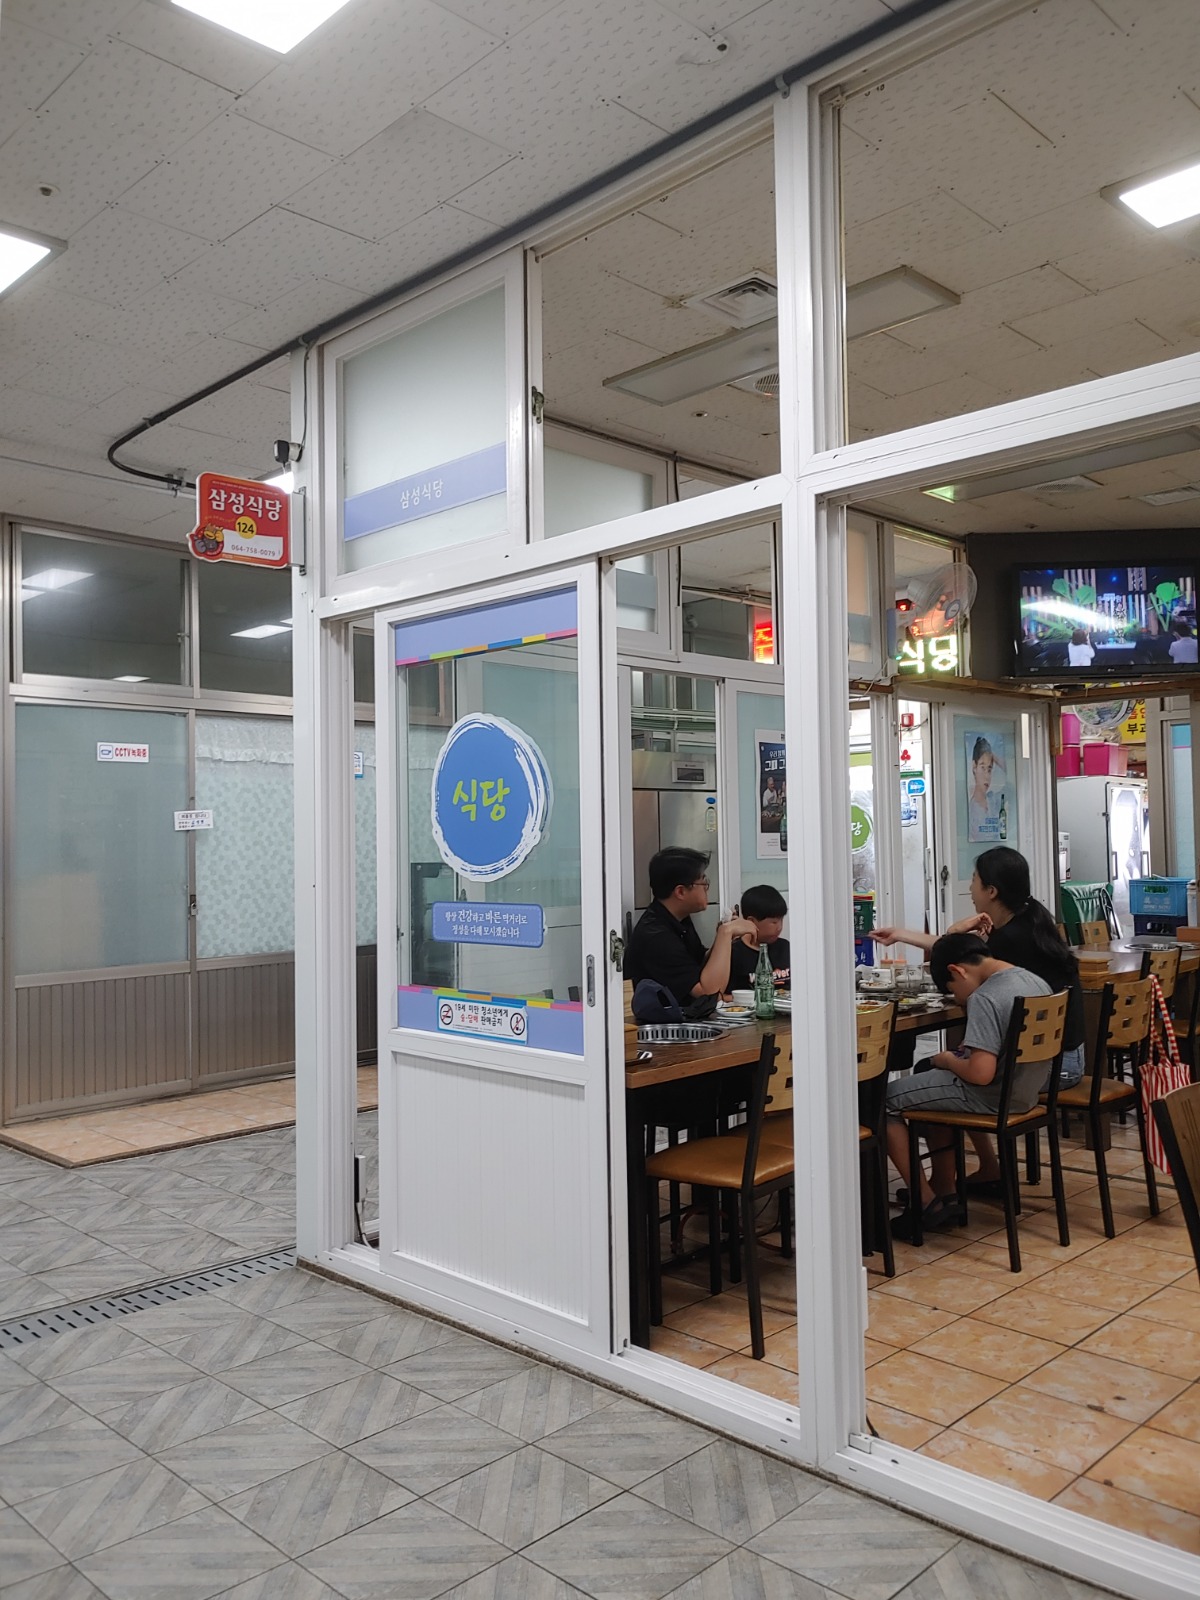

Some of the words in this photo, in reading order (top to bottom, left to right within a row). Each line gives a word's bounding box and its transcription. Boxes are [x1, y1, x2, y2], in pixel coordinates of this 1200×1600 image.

[399, 479, 444, 509] 삼성식당
[208, 488, 282, 521] 삼성식당
[236, 521, 255, 534] 124
[231, 544, 276, 556] 064-758-0079
[899, 634, 958, 674] 식당
[452, 778, 510, 821] 식당
[851, 822, 863, 836] 당
[458, 909, 485, 922] 건강하고
[485, 910, 502, 924] 바른
[502, 913, 528, 925] 먹거리로
[470, 925, 482, 936] 다해
[483, 926, 520, 938] 모시겠습니다
[468, 1005, 480, 1014] 미만
[482, 1006, 509, 1018] 청소년에게
[480, 1017, 503, 1027] 판매금지
